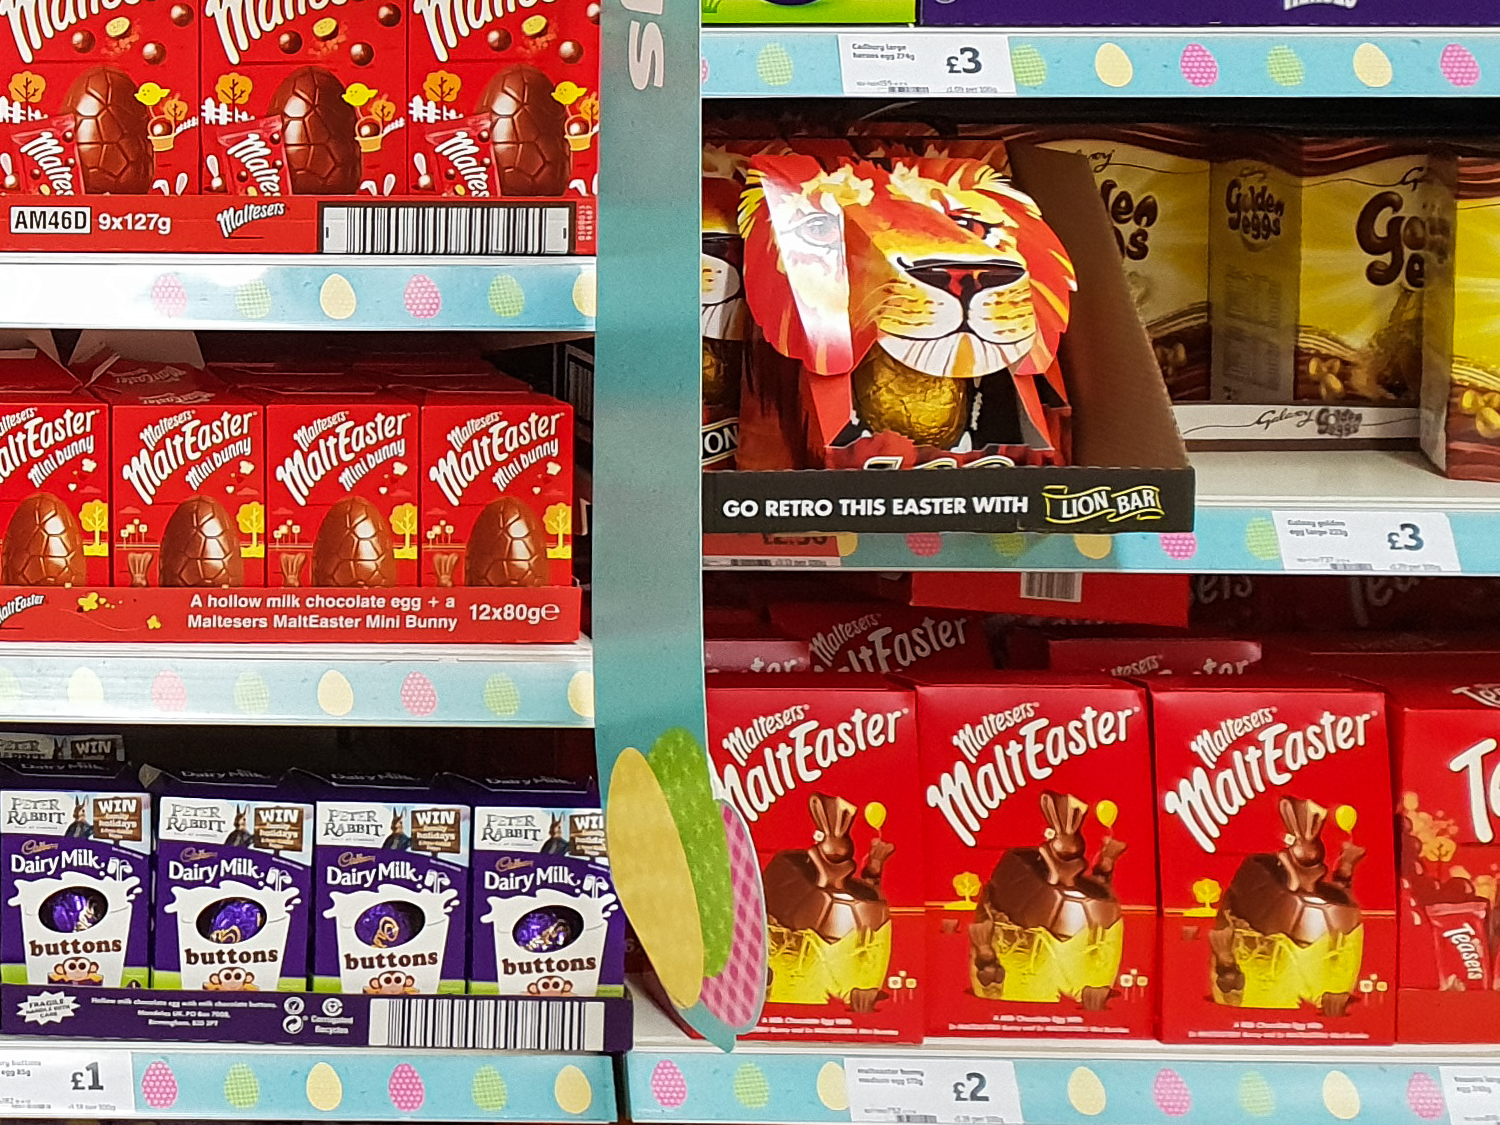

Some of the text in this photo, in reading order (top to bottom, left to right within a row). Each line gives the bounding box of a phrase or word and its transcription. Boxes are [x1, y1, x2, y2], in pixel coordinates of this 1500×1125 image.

[946, 47, 983, 73] £3
[14, 211, 172, 234] AM46D 9x127g
[216, 202, 285, 235] Maltesers
[294, 412, 347, 451] Maltesers
[277, 413, 406, 506] MaltEaster
[368, 438, 405, 472] bunny
[723, 496, 1028, 518] GO RETRO THIS EASTER WITH
[1061, 489, 1157, 518] LION BAR
[1387, 524, 1424, 551] £3
[190, 595, 202, 608] A
[207, 595, 262, 608] hollow
[266, 595, 301, 608] milk
[305, 595, 386, 609] chocolate
[390, 598, 422, 612] egg
[445, 598, 456, 609] a
[187, 615, 458, 632] Maltesers MaltEaster Mini Bunny
[953, 703, 1036, 763] Maltesers
[926, 707, 1133, 845] MaltEaster
[168, 858, 259, 883] Dairy Milk
[344, 951, 439, 971] buttons
[70, 1062, 104, 1090] £1
[953, 1072, 989, 1102] £2
